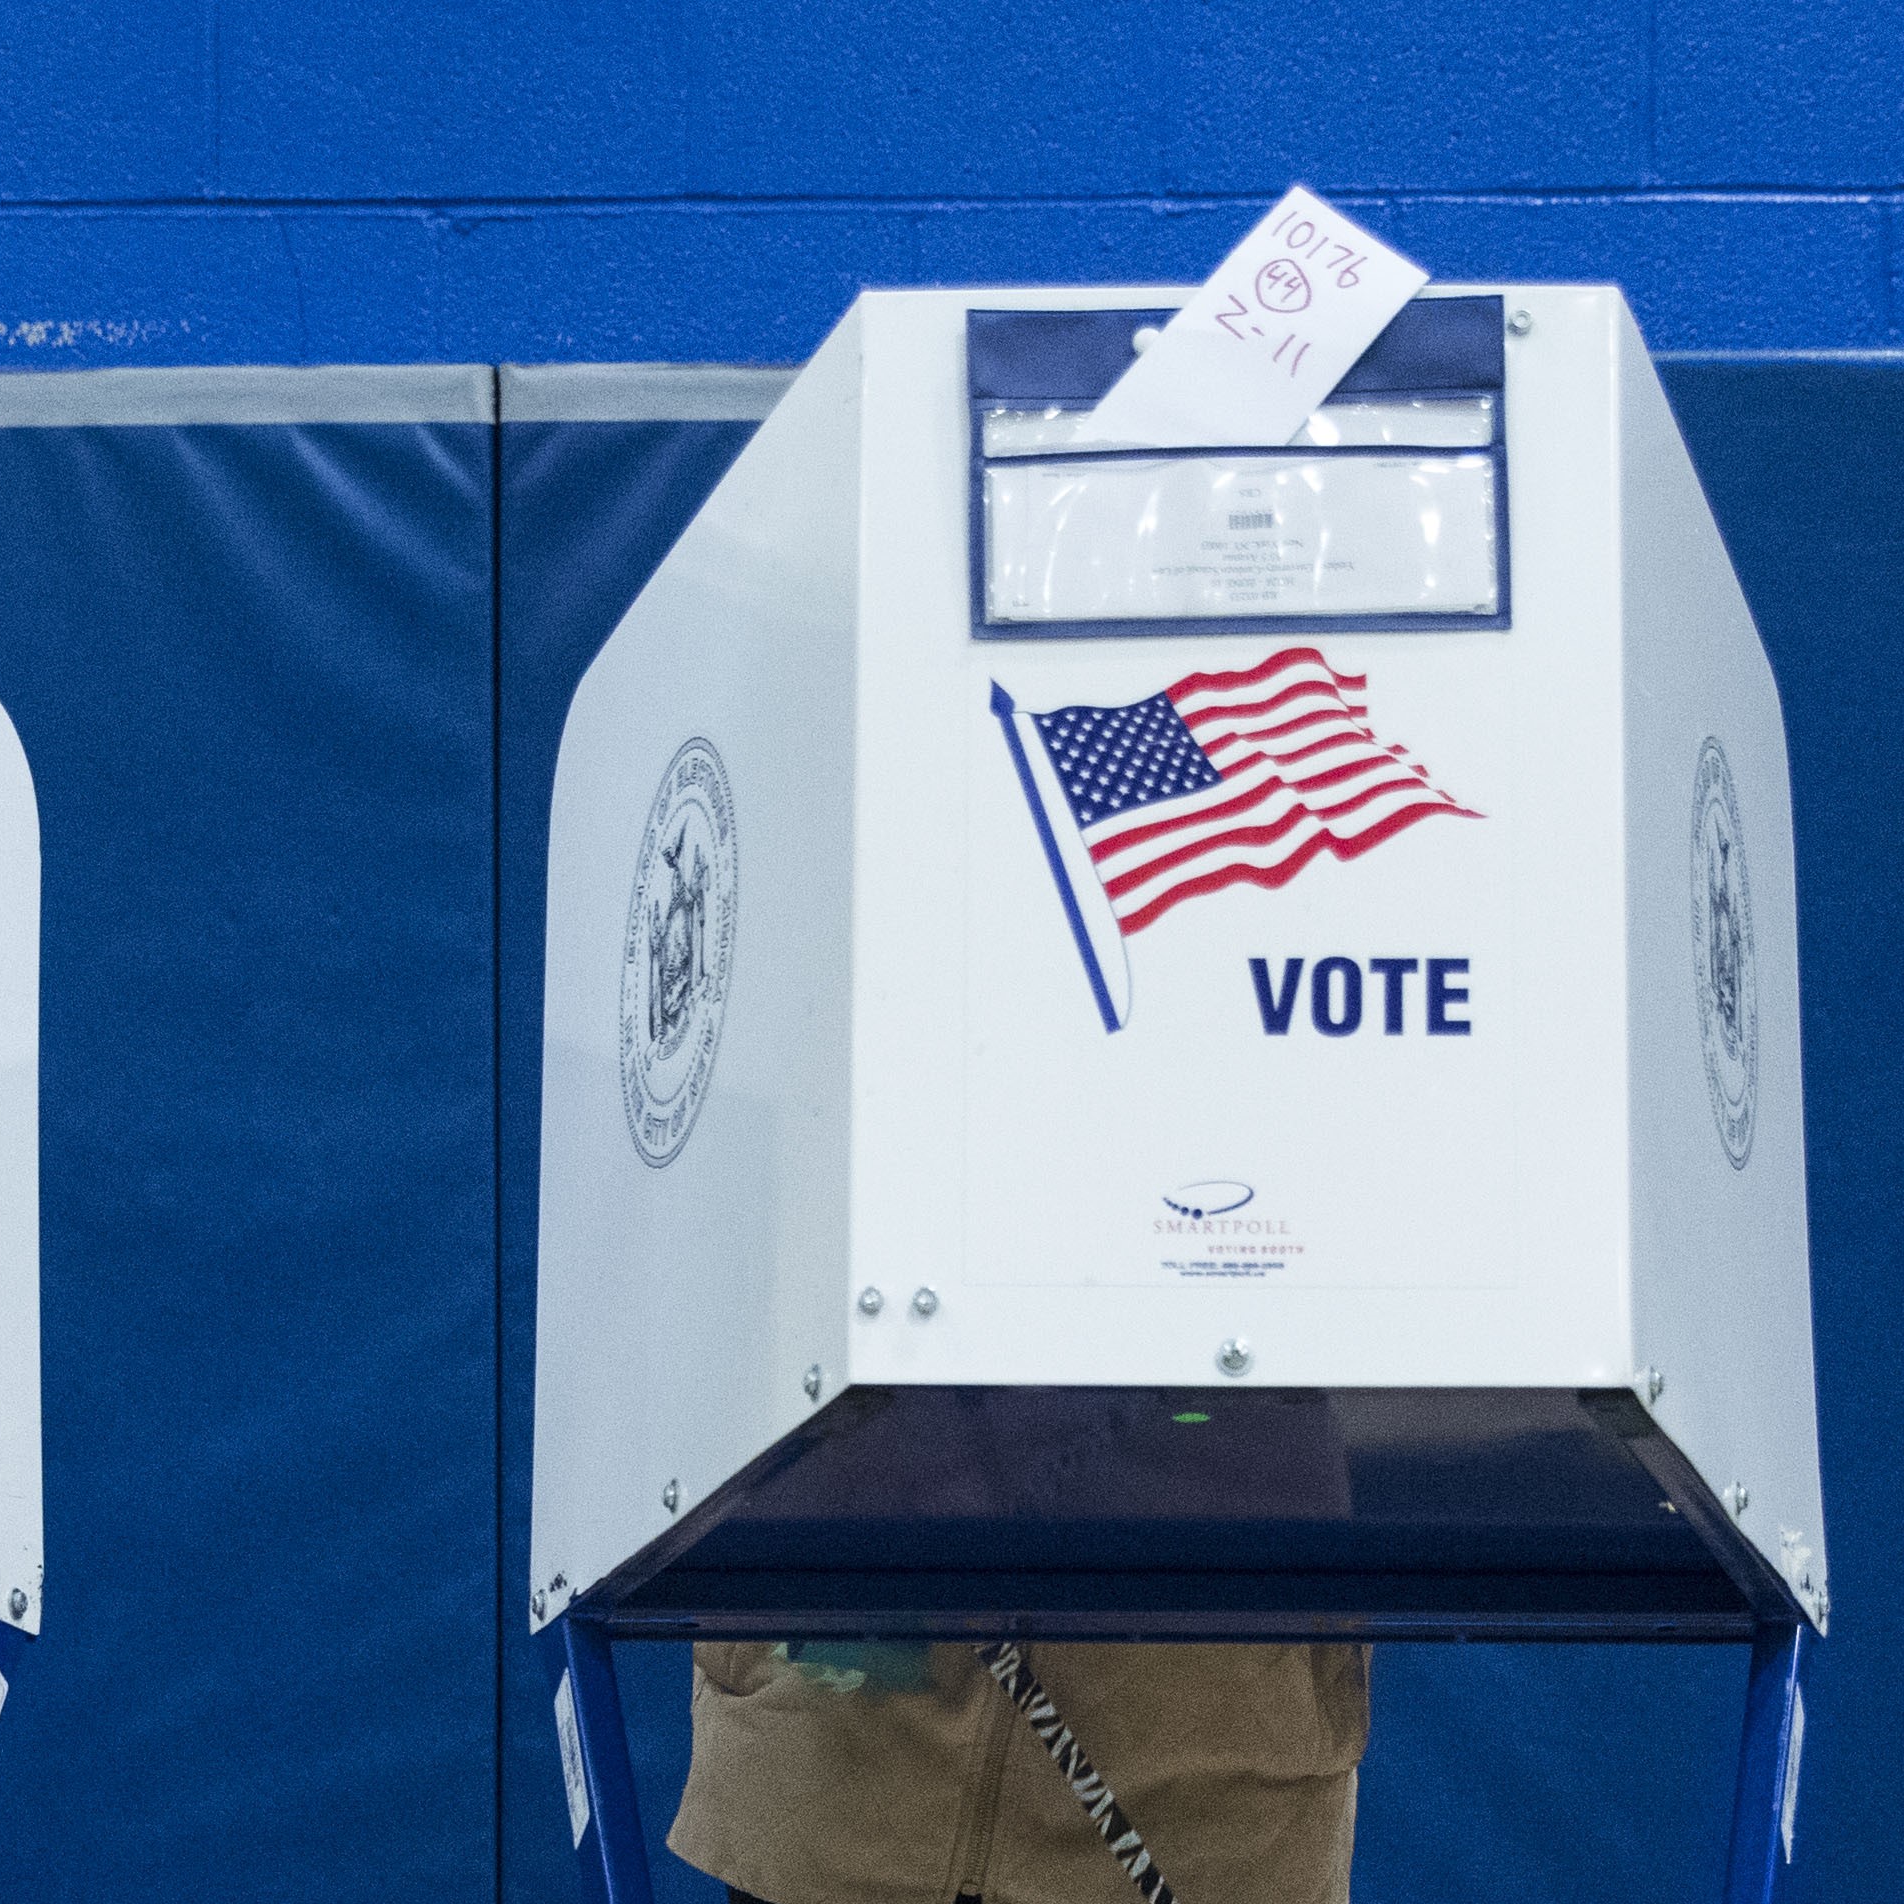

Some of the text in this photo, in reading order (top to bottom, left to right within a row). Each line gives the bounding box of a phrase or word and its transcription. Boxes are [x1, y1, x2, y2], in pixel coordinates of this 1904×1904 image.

[1272, 212, 1368, 288] 10176
[1248, 956, 1472, 1037] VOTE
[1153, 1220, 1291, 1235] SMARTPOLL
